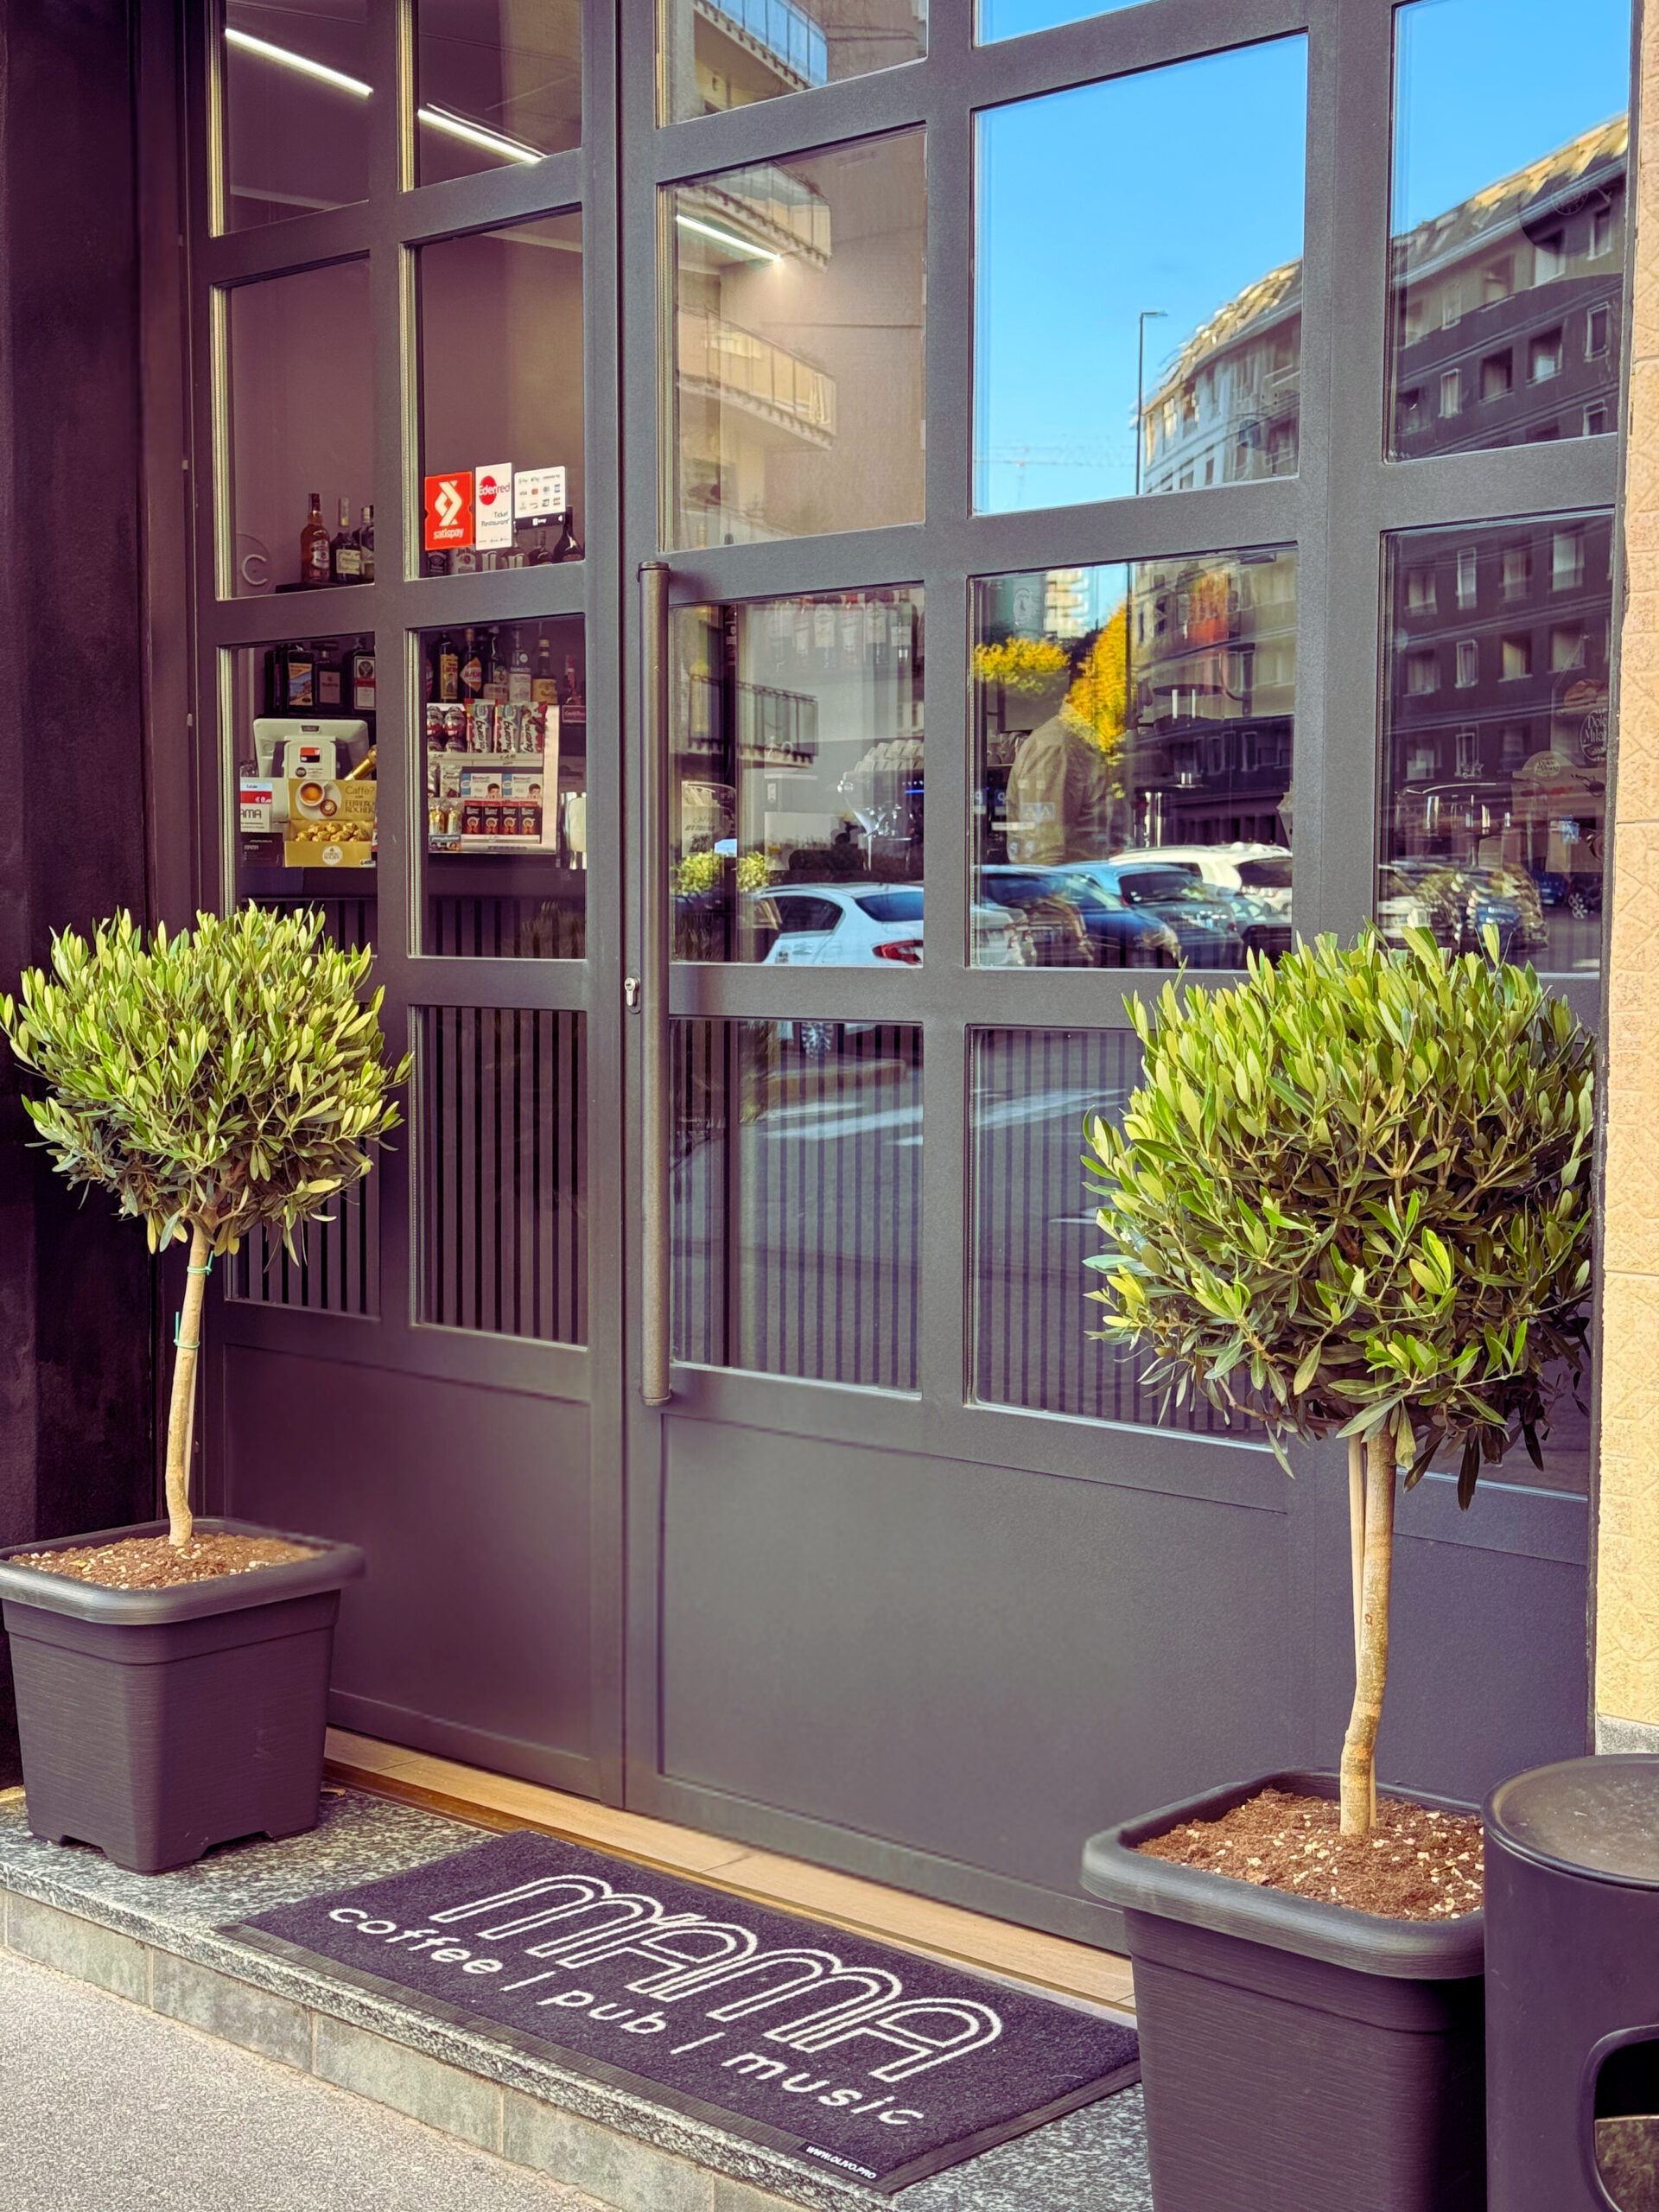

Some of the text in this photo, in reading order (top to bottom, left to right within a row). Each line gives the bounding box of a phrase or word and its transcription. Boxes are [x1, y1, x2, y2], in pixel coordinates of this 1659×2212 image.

[479, 483, 510, 495] Edenred
[433, 528, 463, 539] satispay
[1587, 715, 1608, 728] Dolc
[1583, 728, 1607, 743] Mila
[346, 785, 374, 795] Caffè?
[429, 1874, 1002, 2083] MAMA
[329, 1908, 503, 1974] coffee
[536, 1989, 666, 2035] pub
[721, 2051, 925, 2125] music
[805, 2145, 877, 2179] WWW.OLIVO.PRO
